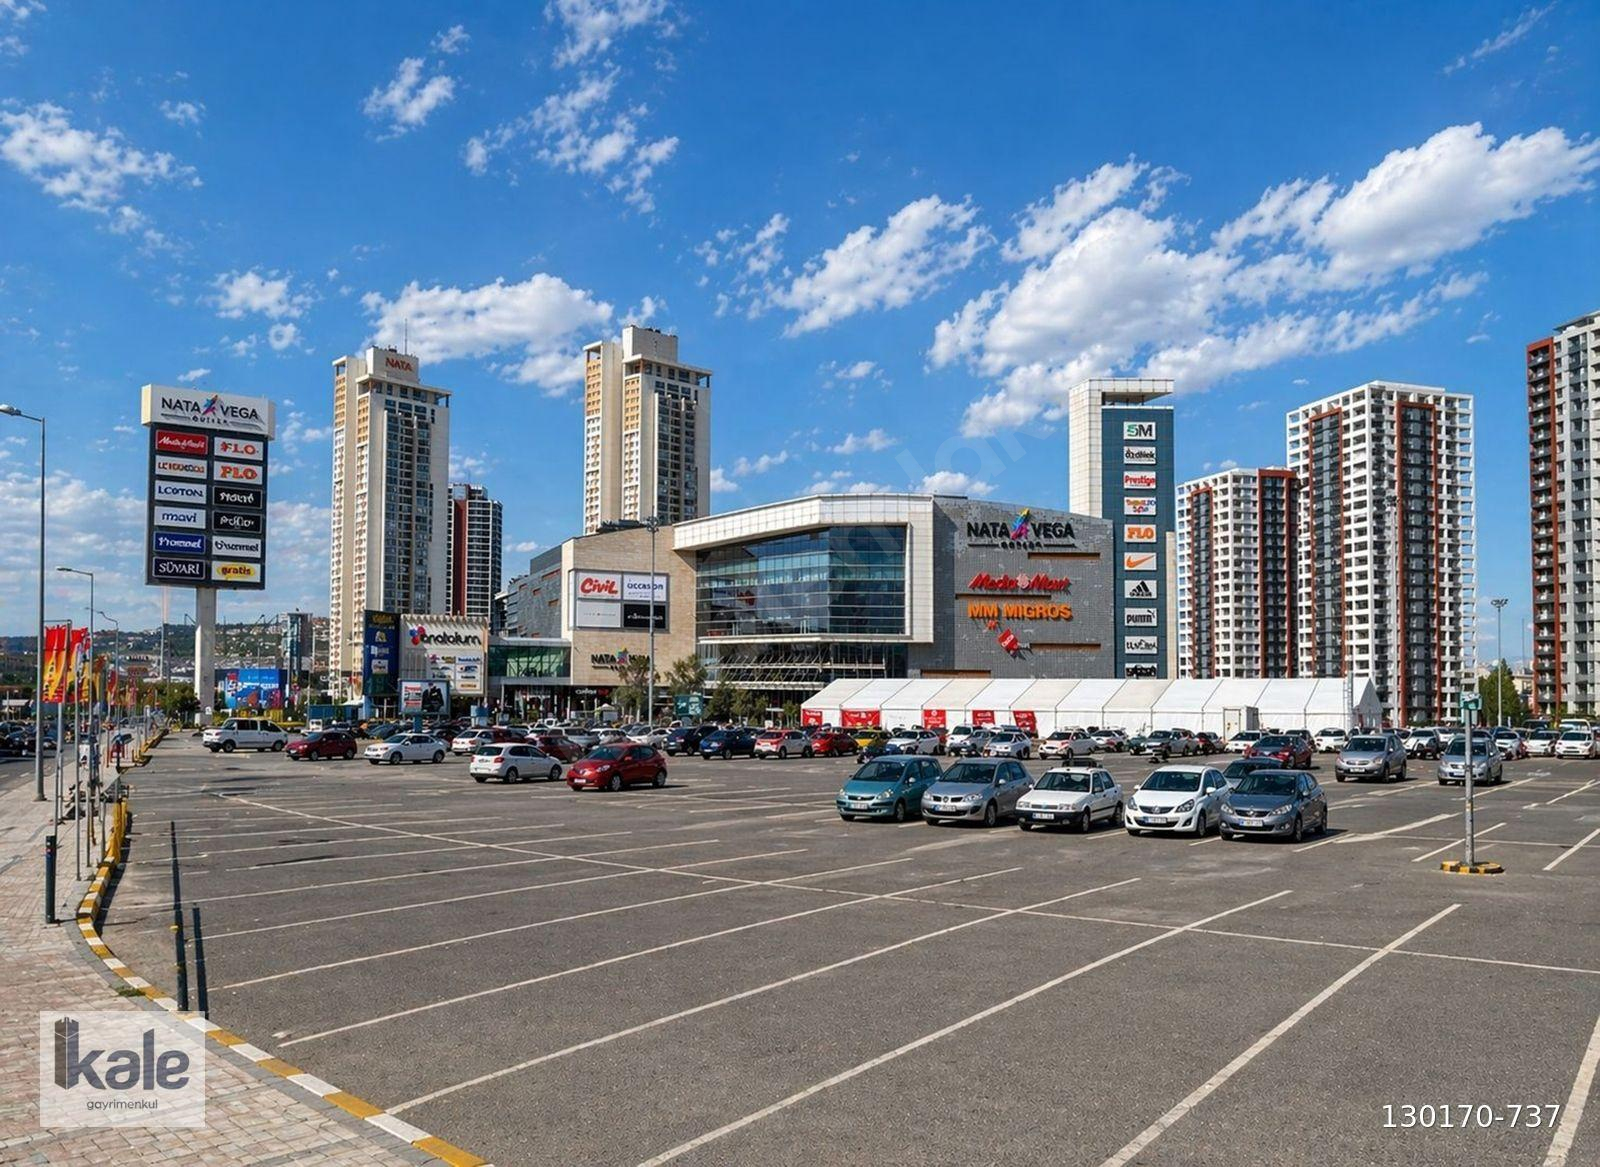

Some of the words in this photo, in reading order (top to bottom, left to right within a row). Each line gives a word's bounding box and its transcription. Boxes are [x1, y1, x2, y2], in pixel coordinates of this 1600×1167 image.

[386, 357, 413, 372] NATA
[161, 397, 201, 414] NATA
[220, 404, 259, 420] VEGA
[966, 521, 1010, 539] NATA
[1031, 521, 1076, 539] VEGA
[1127, 527, 1155, 540] FLO
[221, 565, 252, 576] gratis
[968, 602, 998, 619] MM
[1002, 602, 1073, 620] MIGROS
